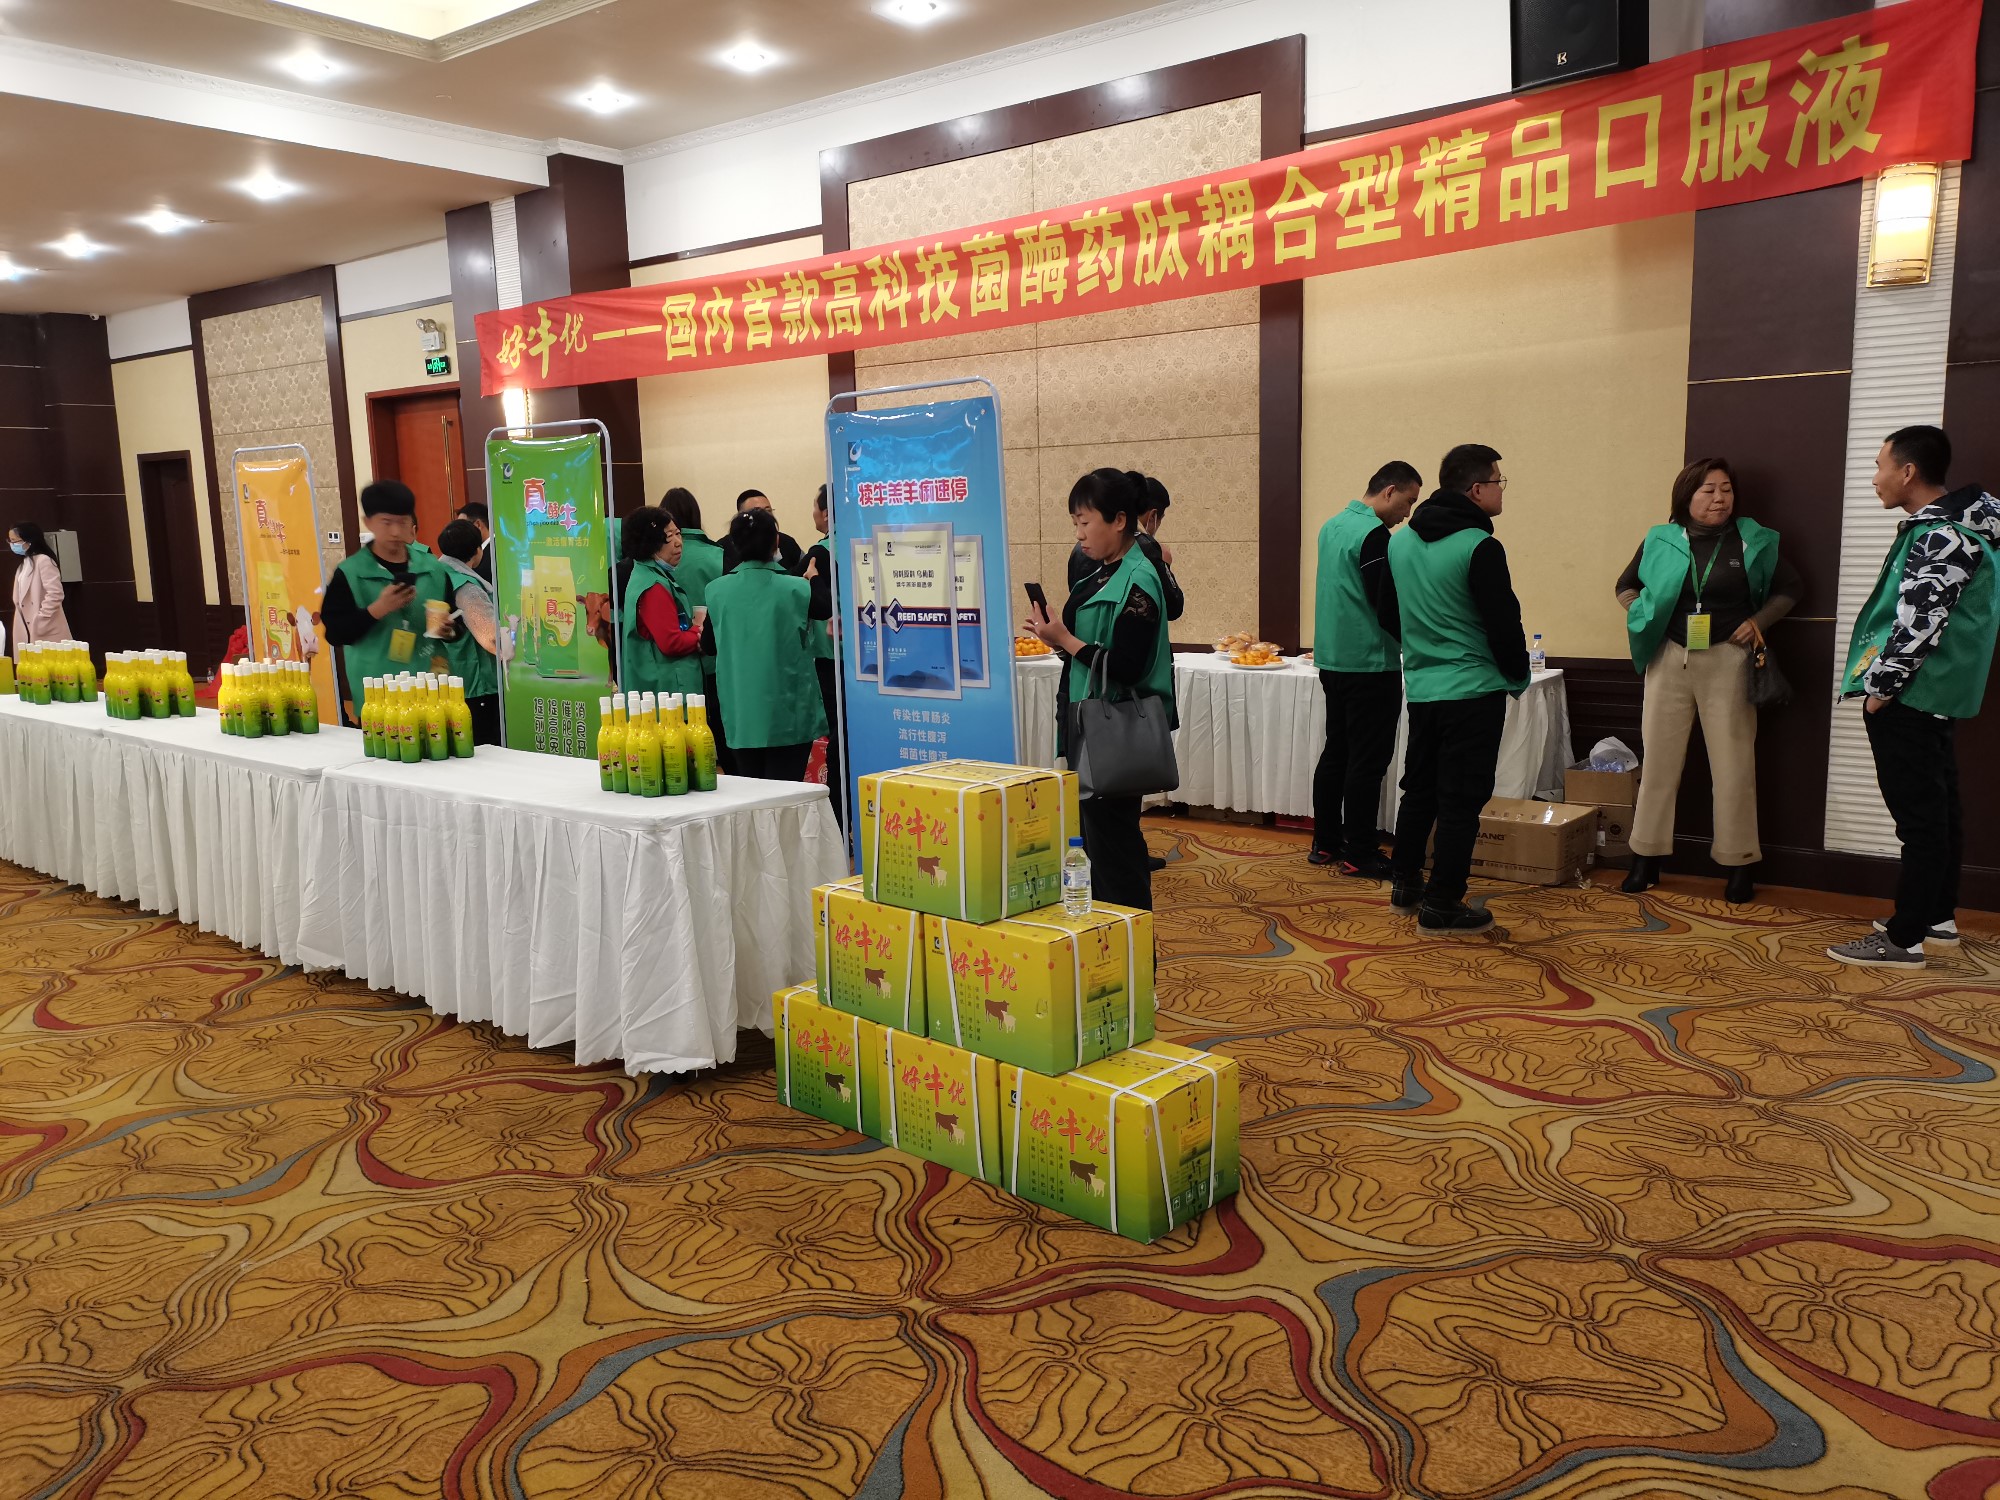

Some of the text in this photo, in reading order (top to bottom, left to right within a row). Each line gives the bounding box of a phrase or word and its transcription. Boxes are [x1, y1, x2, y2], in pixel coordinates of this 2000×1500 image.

[918, 612, 948, 622] SAFETY
[893, 708, 951, 725] 传染性胃肠炎
[898, 727, 947, 744] 流行性腹泻
[899, 747, 948, 762] 细菌性腹泻
[884, 807, 949, 851] 好牛优
[836, 920, 893, 963] 好牛优
[902, 1064, 967, 1107] 好牛优
[1030, 1107, 1108, 1154] 好牛优
